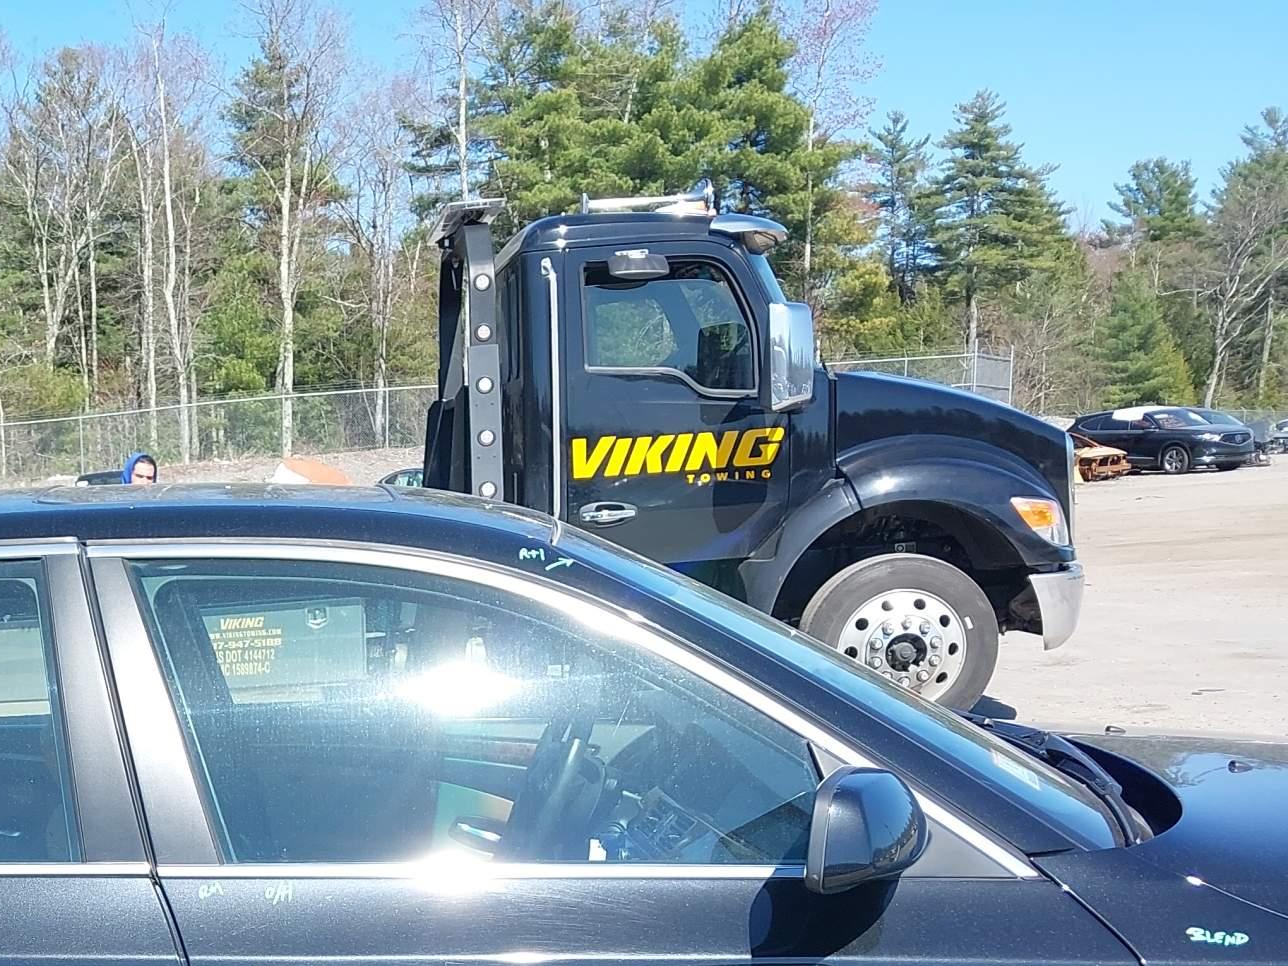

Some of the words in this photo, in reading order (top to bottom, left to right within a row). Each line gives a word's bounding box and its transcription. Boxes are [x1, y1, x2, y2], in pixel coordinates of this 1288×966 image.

[571, 427, 785, 479] VIKING
[687, 469, 772, 484] TOWING
[220, 616, 265, 630] VIKING
